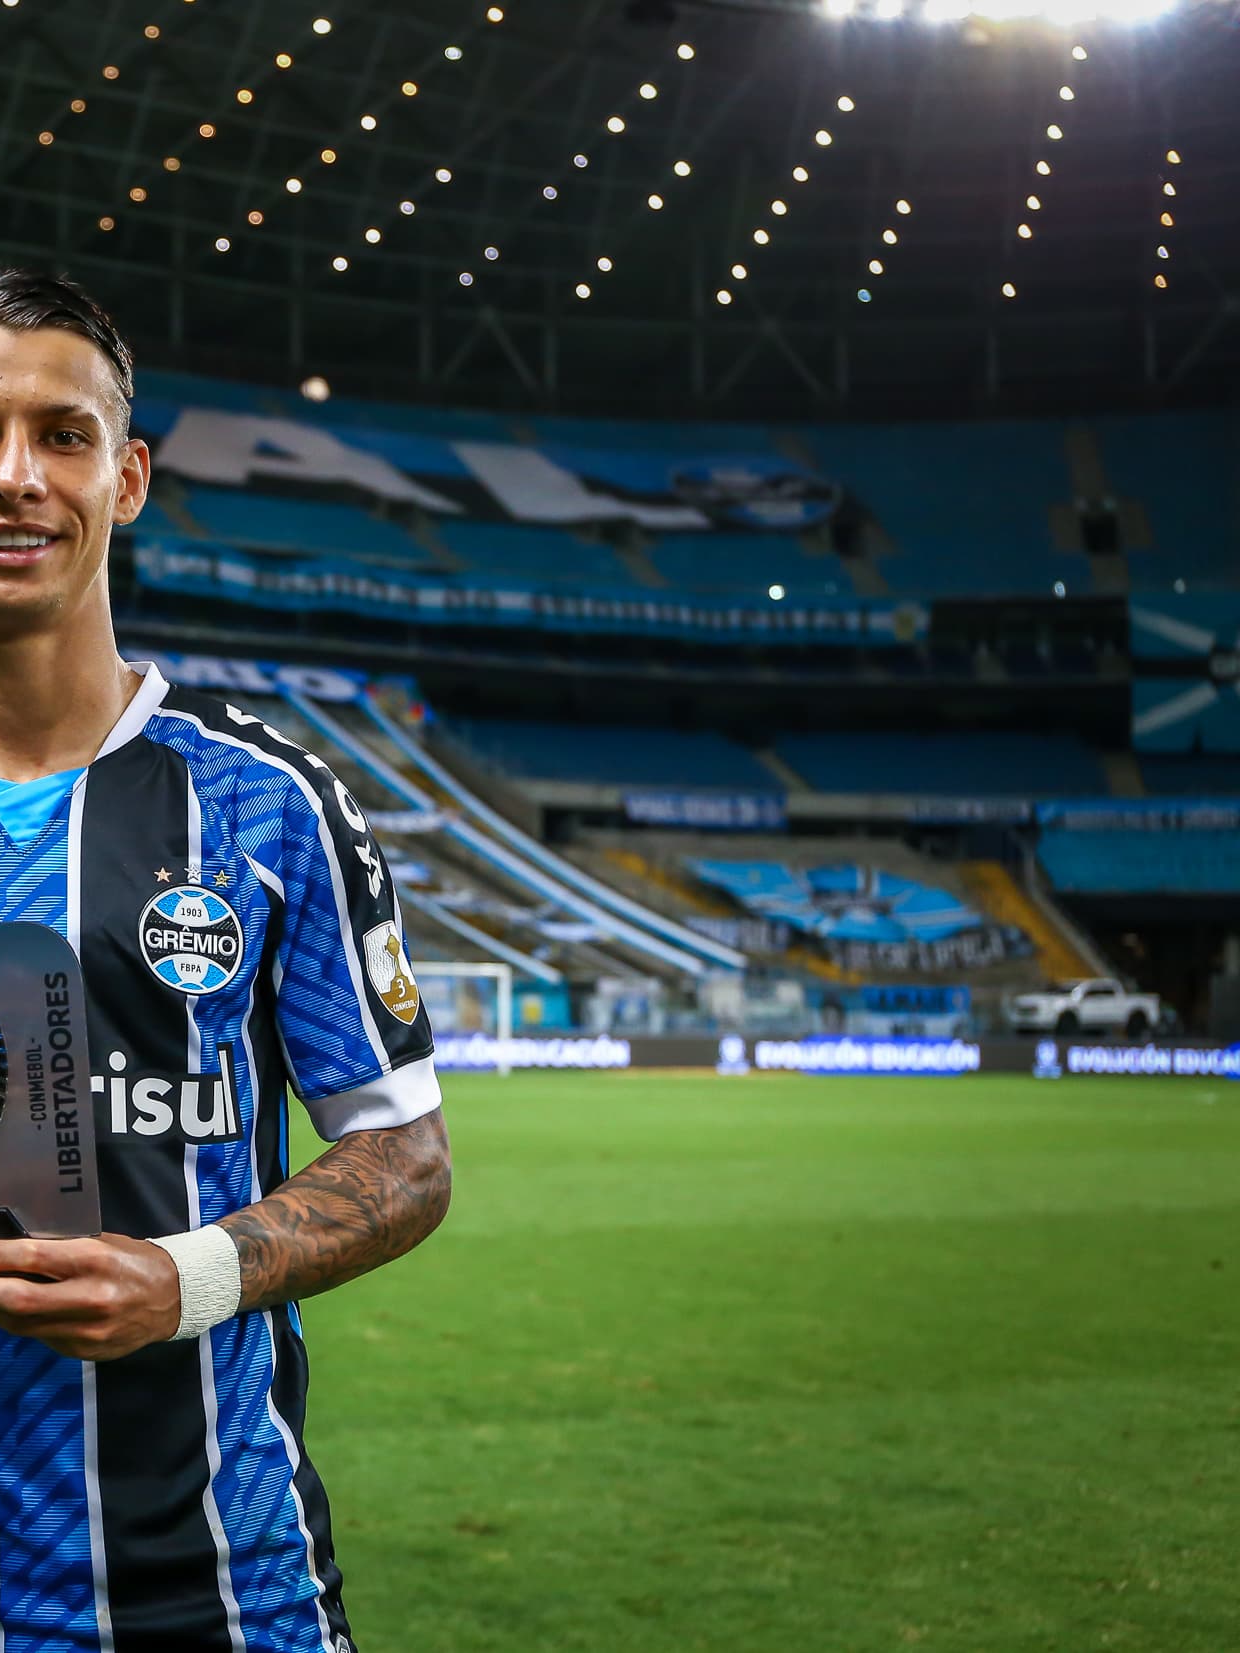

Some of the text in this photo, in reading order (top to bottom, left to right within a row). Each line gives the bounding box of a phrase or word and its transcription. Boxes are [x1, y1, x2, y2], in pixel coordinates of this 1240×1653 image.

[180, 907, 202, 918] 1903
[145, 926, 237, 957] GRÊMIO
[180, 962, 202, 974] FBPA
[396, 978, 406, 998] 3
[44, 971, 83, 1193] LIBERTADORES
[90, 1050, 237, 1137] isul
